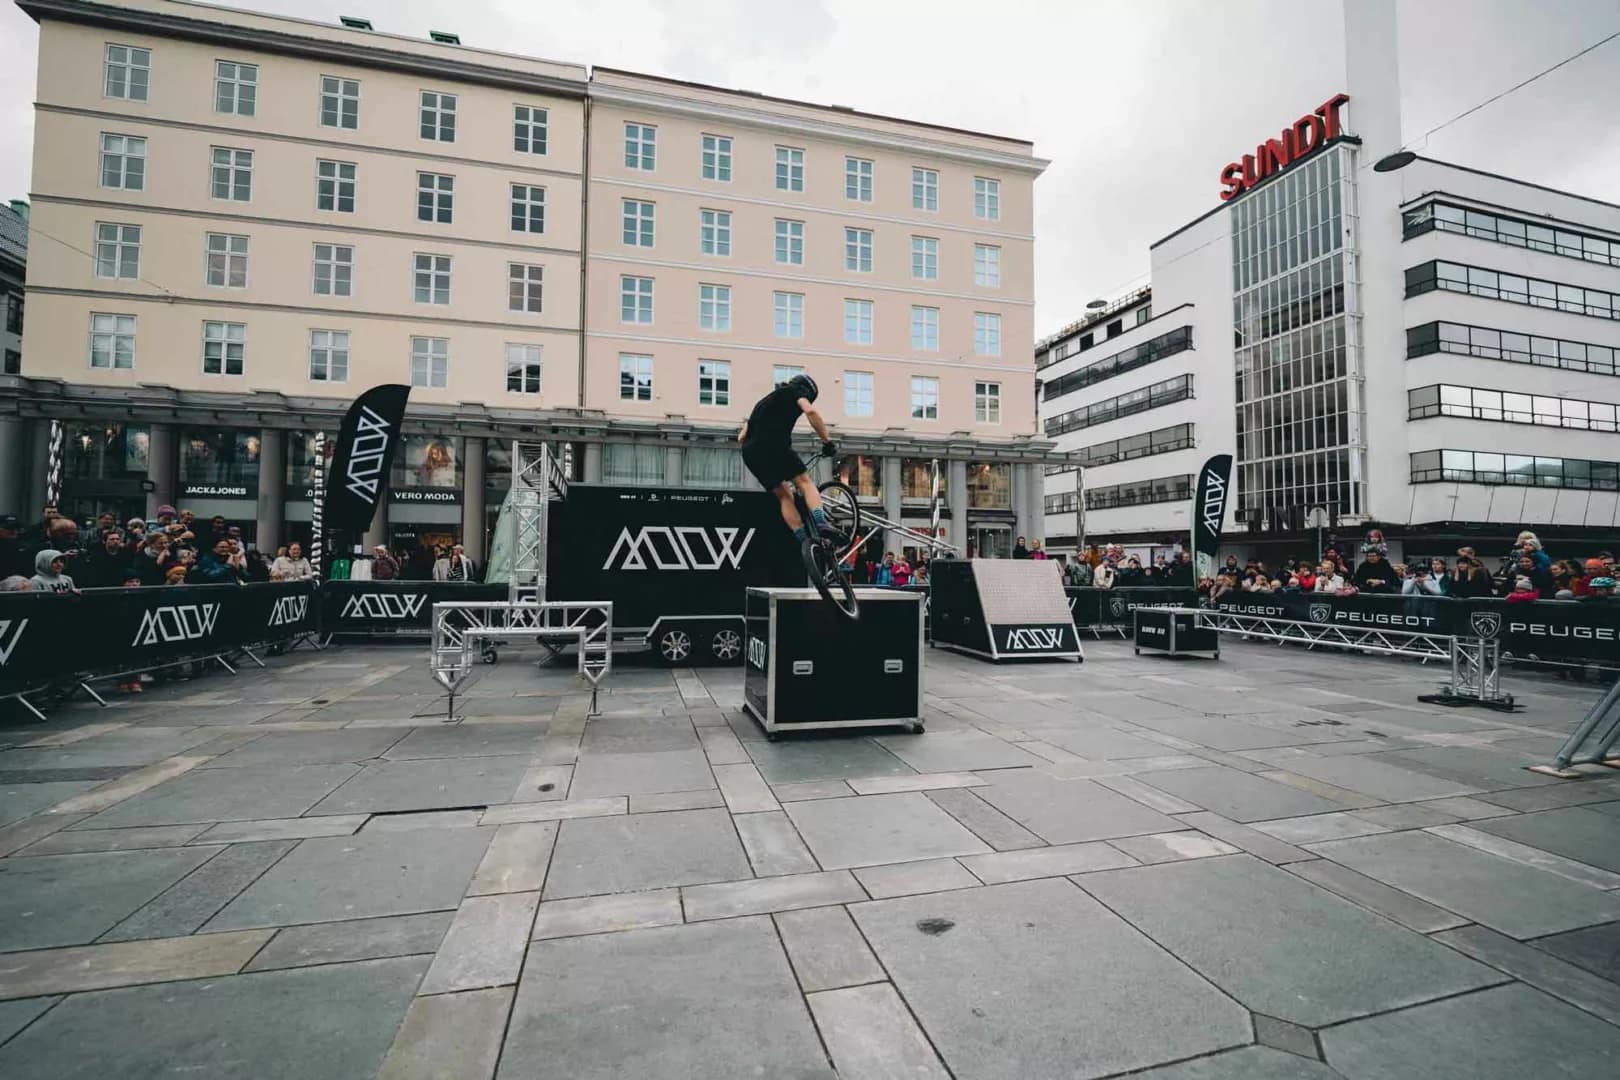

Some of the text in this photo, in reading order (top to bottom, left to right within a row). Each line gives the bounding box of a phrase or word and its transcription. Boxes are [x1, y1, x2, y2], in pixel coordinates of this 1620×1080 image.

[1220, 93, 1350, 201] SUNDT
[185, 486, 247, 495] JACK&JONES
[394, 492, 455, 501] VERO MODA
[1219, 603, 1285, 617] PEUGEOT
[1335, 611, 1435, 627] PEUGEOT
[1510, 622, 1620, 641] PEUGE
